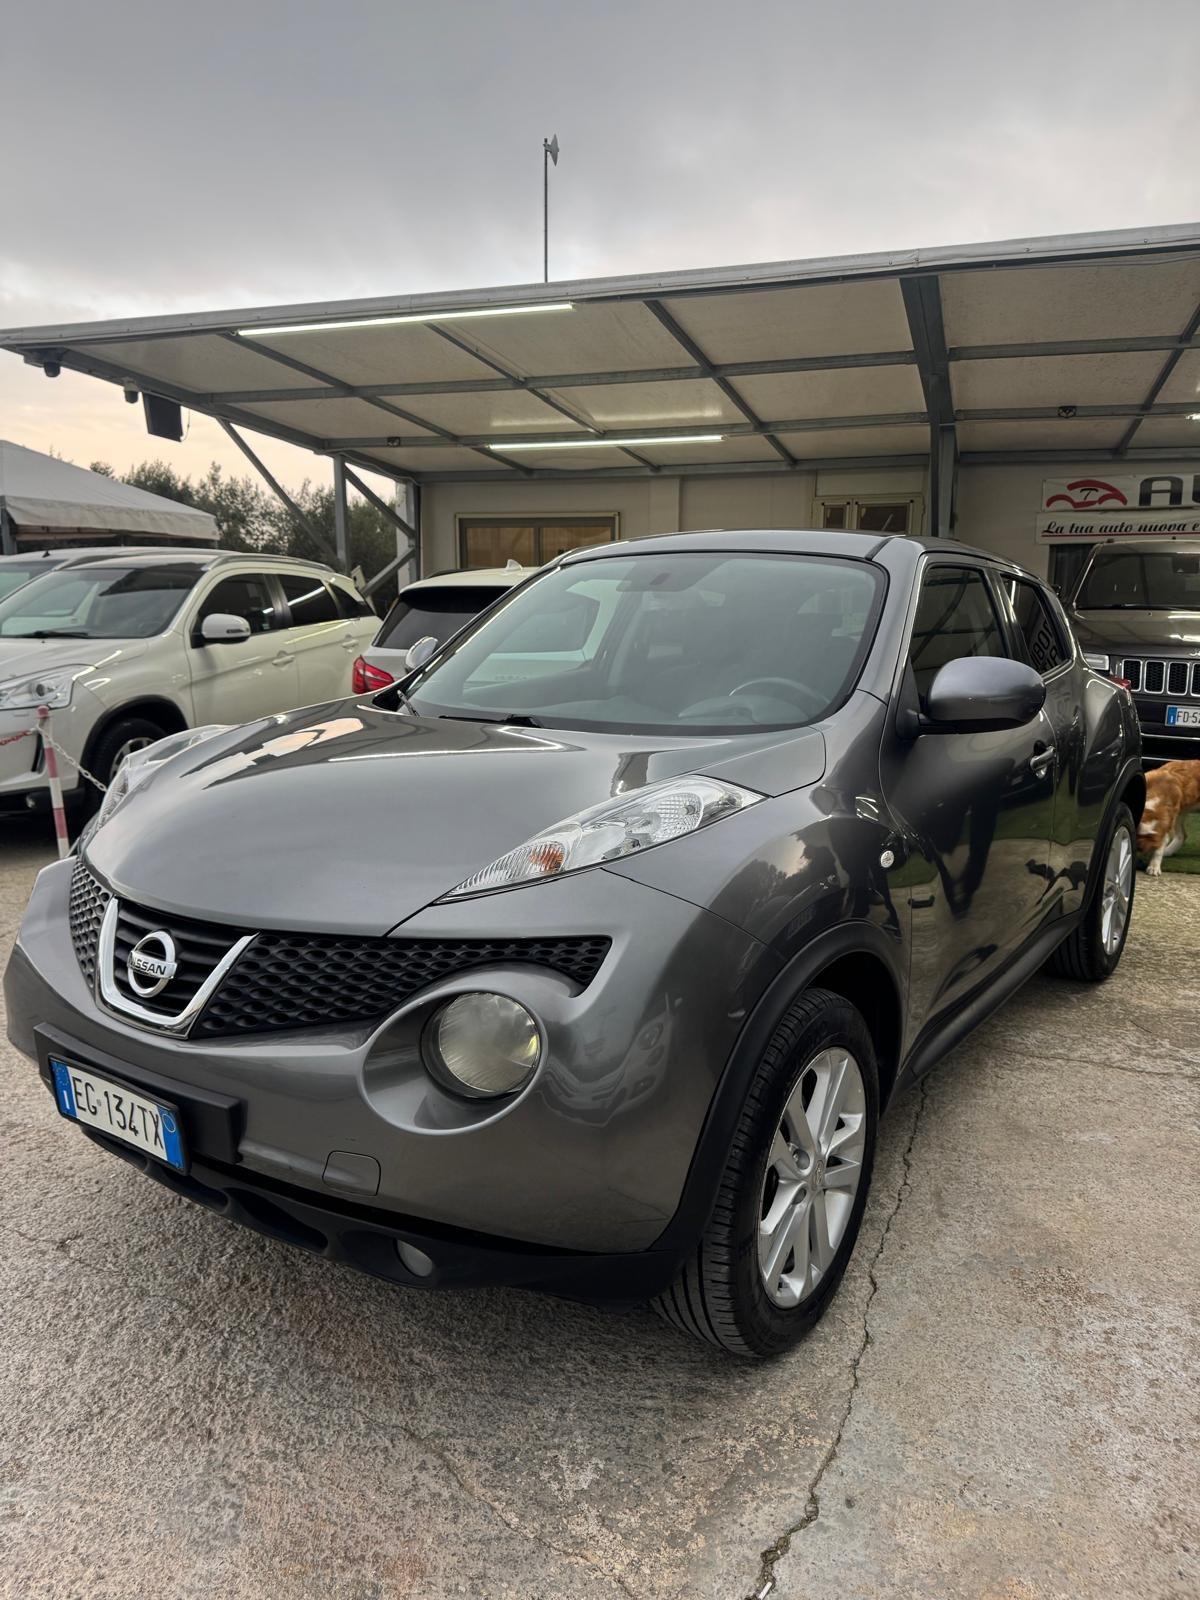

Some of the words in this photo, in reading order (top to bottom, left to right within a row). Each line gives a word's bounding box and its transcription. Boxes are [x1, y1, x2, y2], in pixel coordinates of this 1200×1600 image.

[1139, 474, 1200, 506] A
[1042, 521, 1064, 534] La
[1068, 523, 1094, 533] tua
[1098, 521, 1133, 533] auto
[1137, 522, 1187, 533] nuova
[130, 955, 167, 975] NISSAN
